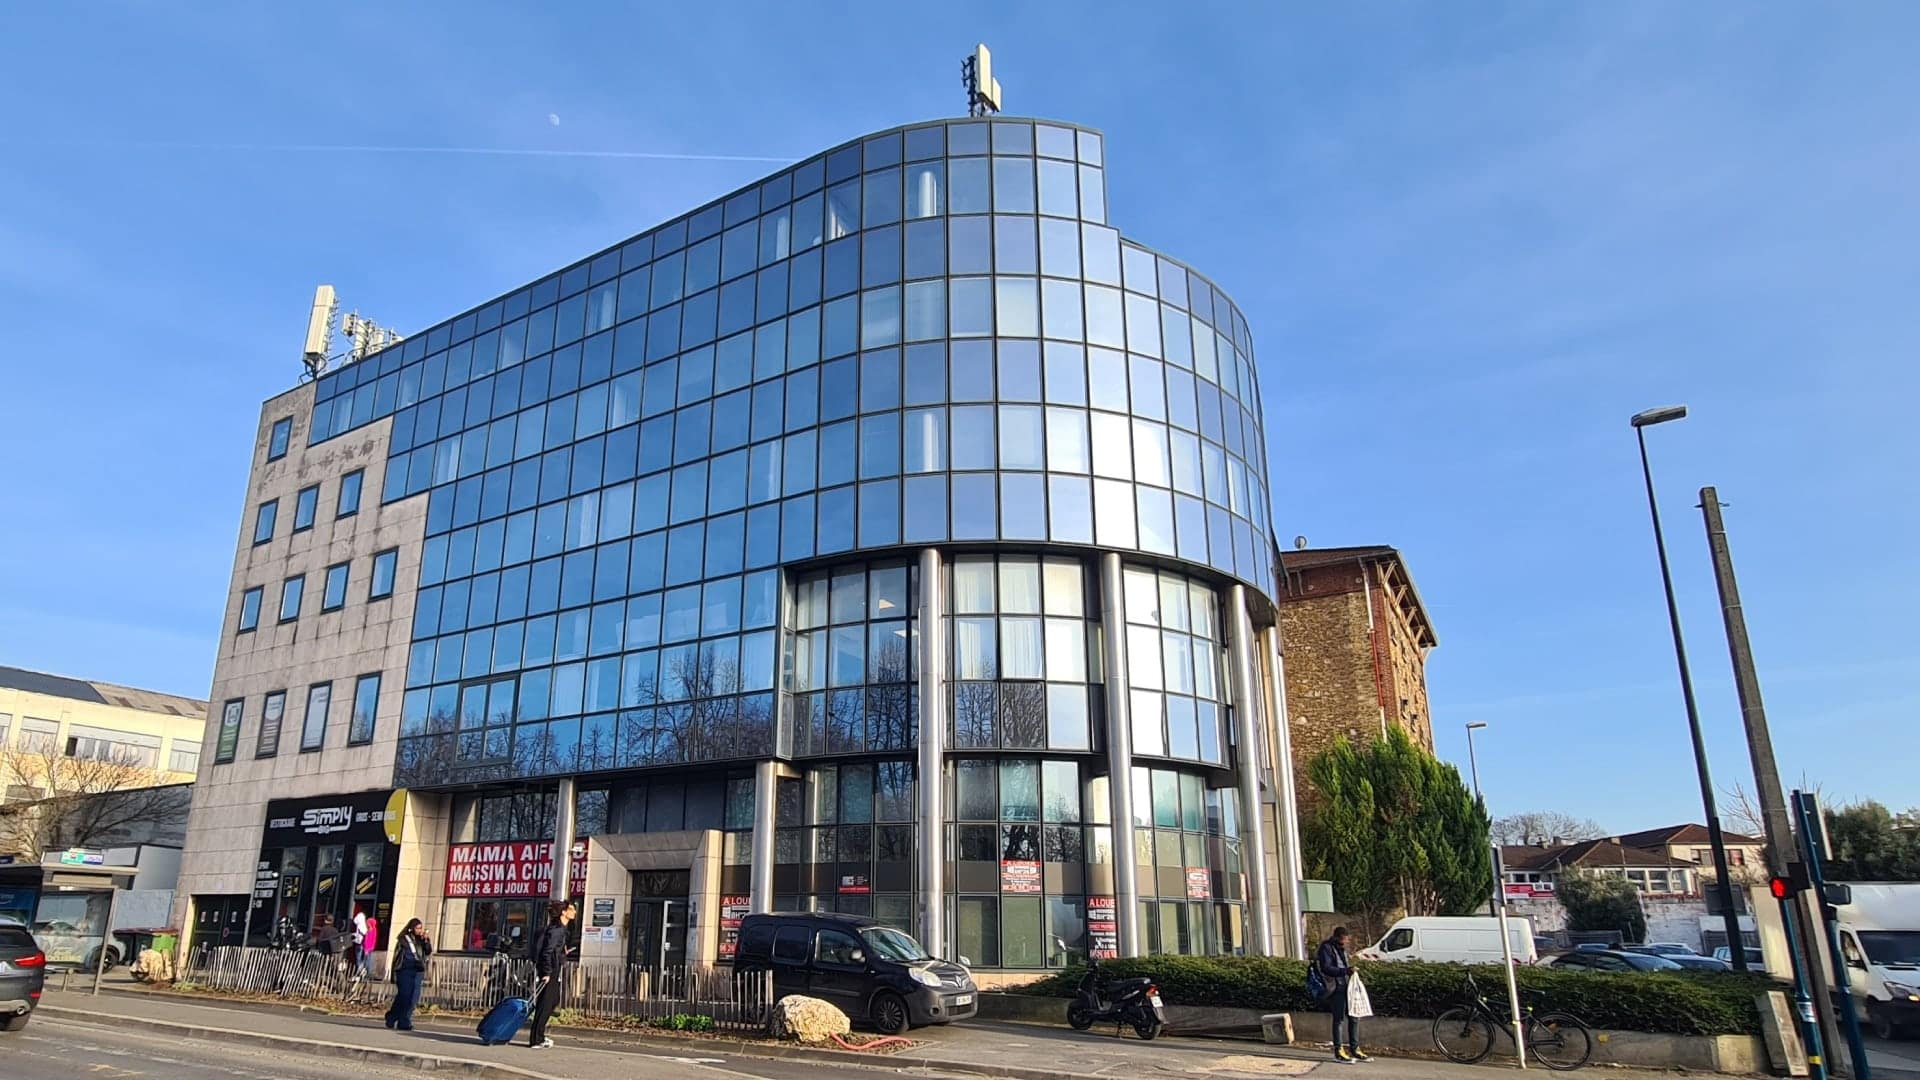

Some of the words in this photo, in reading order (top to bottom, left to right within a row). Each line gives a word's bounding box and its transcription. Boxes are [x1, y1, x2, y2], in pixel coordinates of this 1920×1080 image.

[453, 846, 514, 862] MAMA
[450, 863, 516, 882] MASSIWA
[449, 883, 480, 895] TISSUS
[482, 883, 491, 894] &
